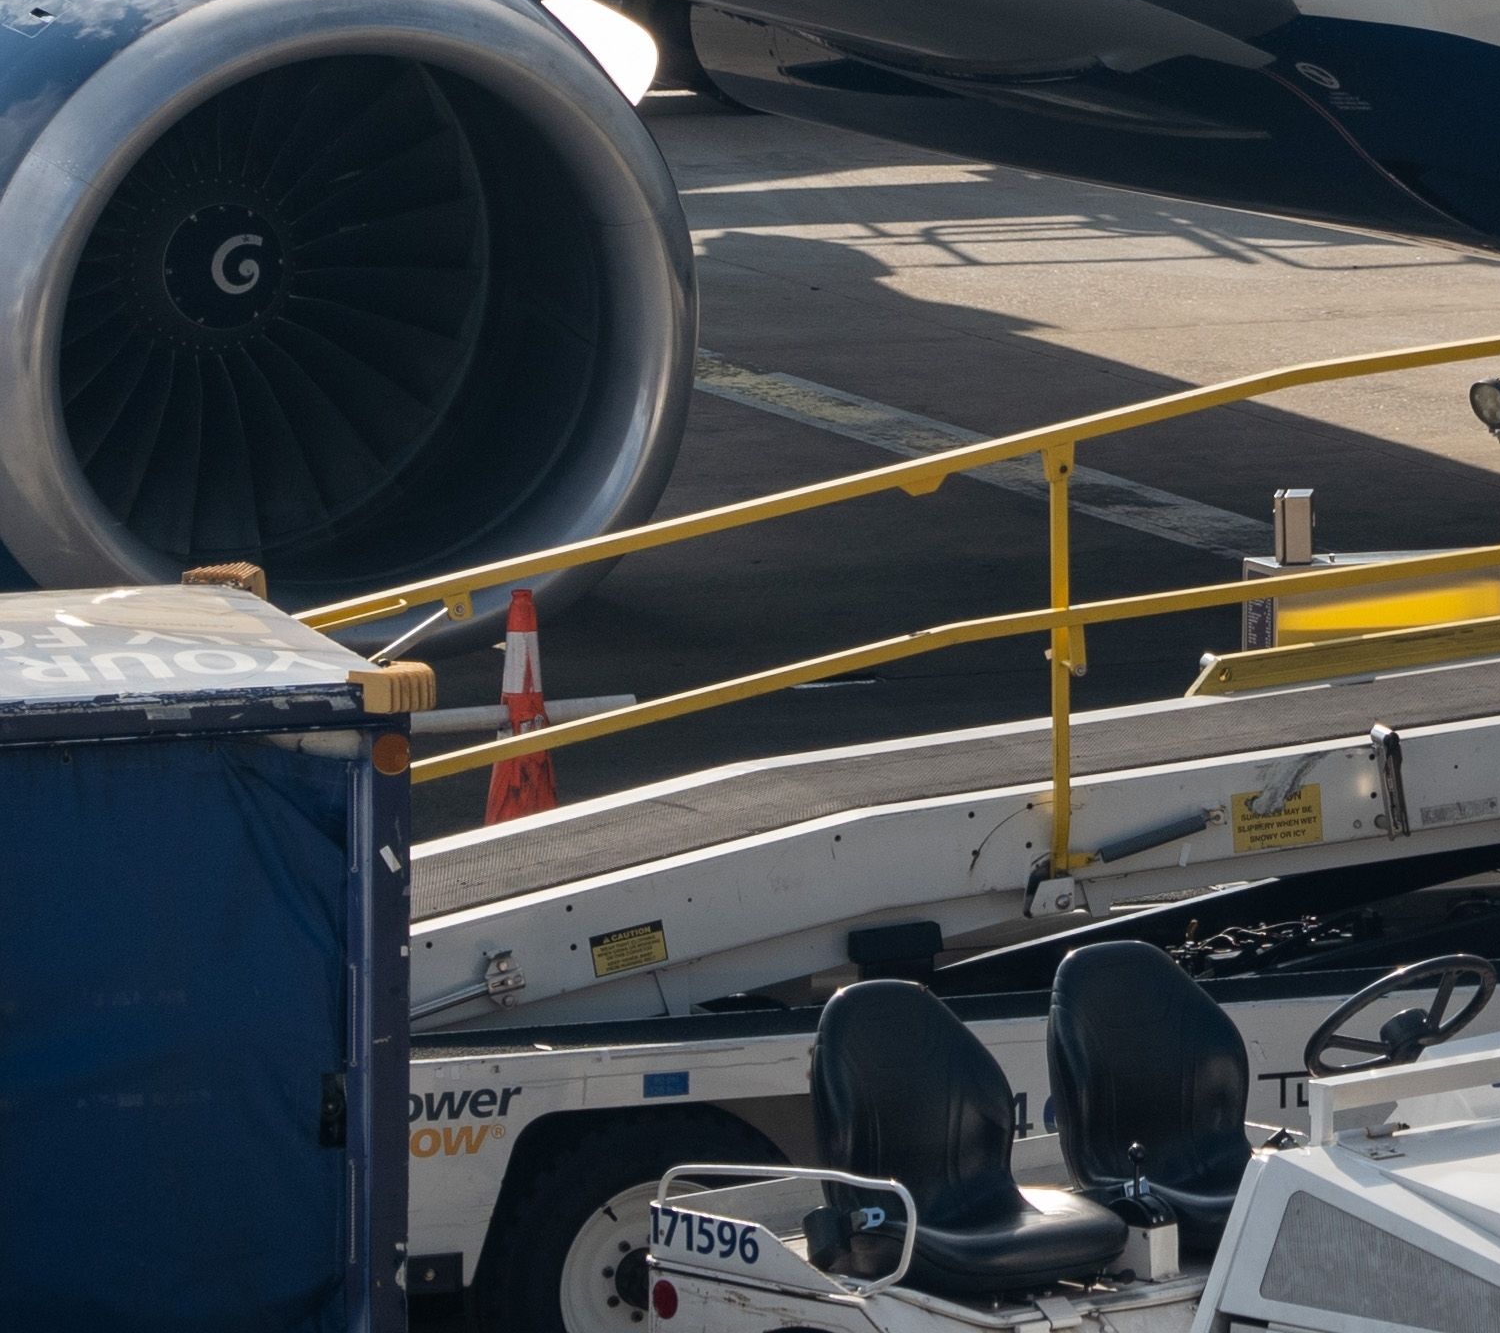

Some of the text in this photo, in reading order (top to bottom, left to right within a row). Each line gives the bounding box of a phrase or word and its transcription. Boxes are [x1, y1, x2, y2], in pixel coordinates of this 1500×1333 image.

[5, 649, 343, 683] YOUR
[1284, 806, 1299, 815] MAY
[1302, 805, 1312, 813] BE
[1237, 816, 1317, 833] SLIPPERY WHEN WET
[1250, 833, 1277, 843] SNOWY
[1293, 829, 1306, 837] ICY
[611, 926, 652, 941] CAUTION
[651, 1205, 760, 1264] 171596
